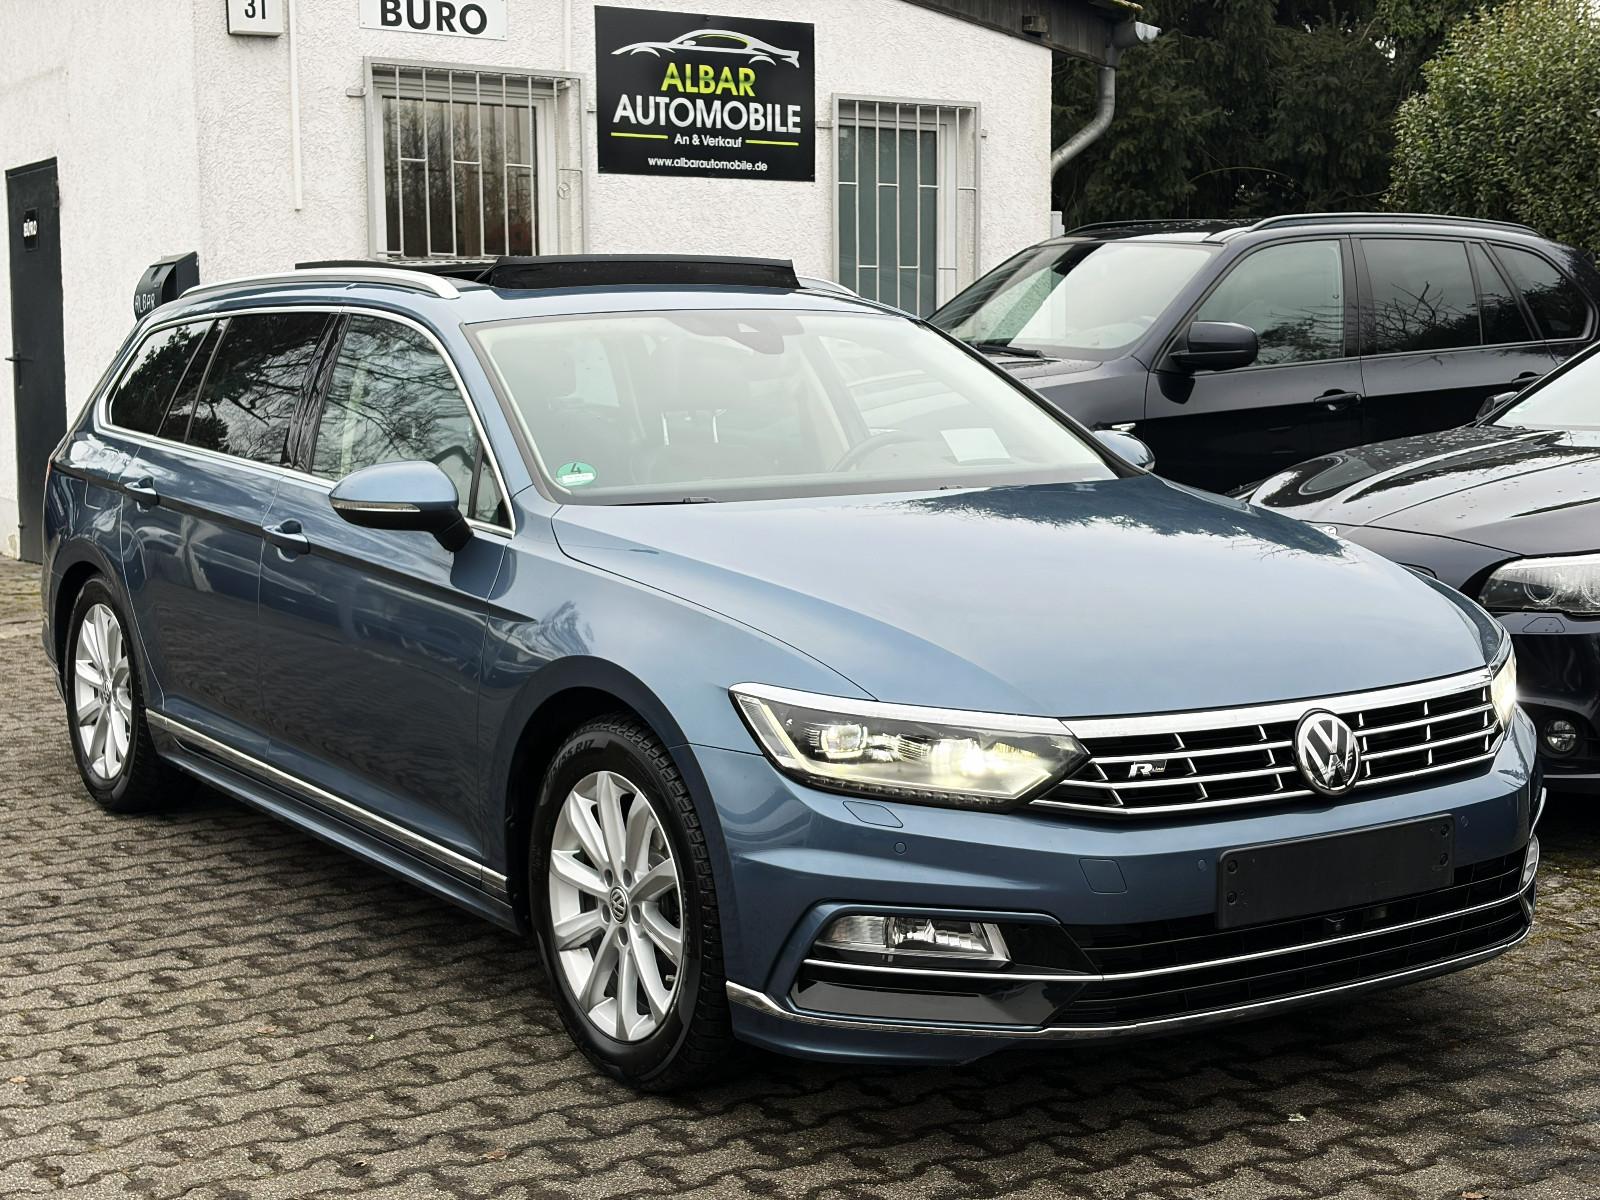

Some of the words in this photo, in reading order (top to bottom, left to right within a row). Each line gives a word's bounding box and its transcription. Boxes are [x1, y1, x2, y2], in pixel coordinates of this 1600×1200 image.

[660, 62, 756, 97] ALBAR
[612, 94, 801, 134] AUTOMOBILE
[674, 133, 690, 146] An
[692, 134, 700, 146] &
[701, 135, 743, 148] Verkauf
[647, 157, 768, 172] www.albarautomobile.de
